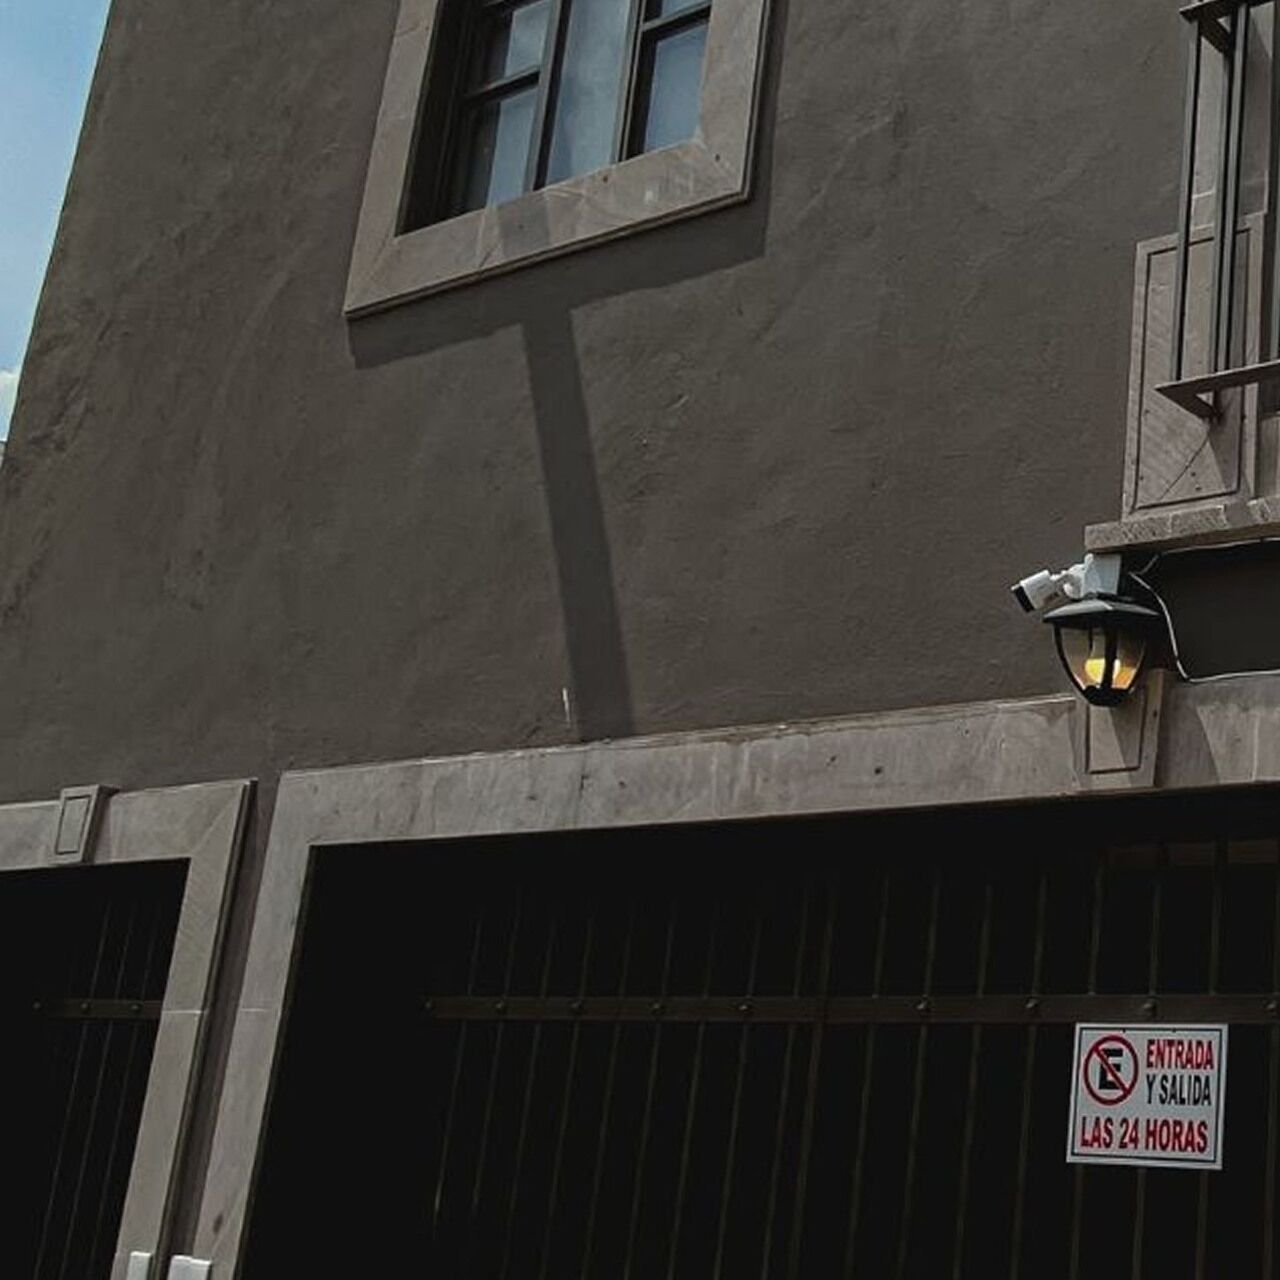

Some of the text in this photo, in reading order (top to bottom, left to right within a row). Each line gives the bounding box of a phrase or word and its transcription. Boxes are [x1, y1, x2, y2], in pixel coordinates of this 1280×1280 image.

[1146, 1039, 1214, 1070] ENTRADA
[1146, 1075, 1212, 1106] Y SALIDA
[1080, 1116, 1208, 1153] LAS 24 HORAS
